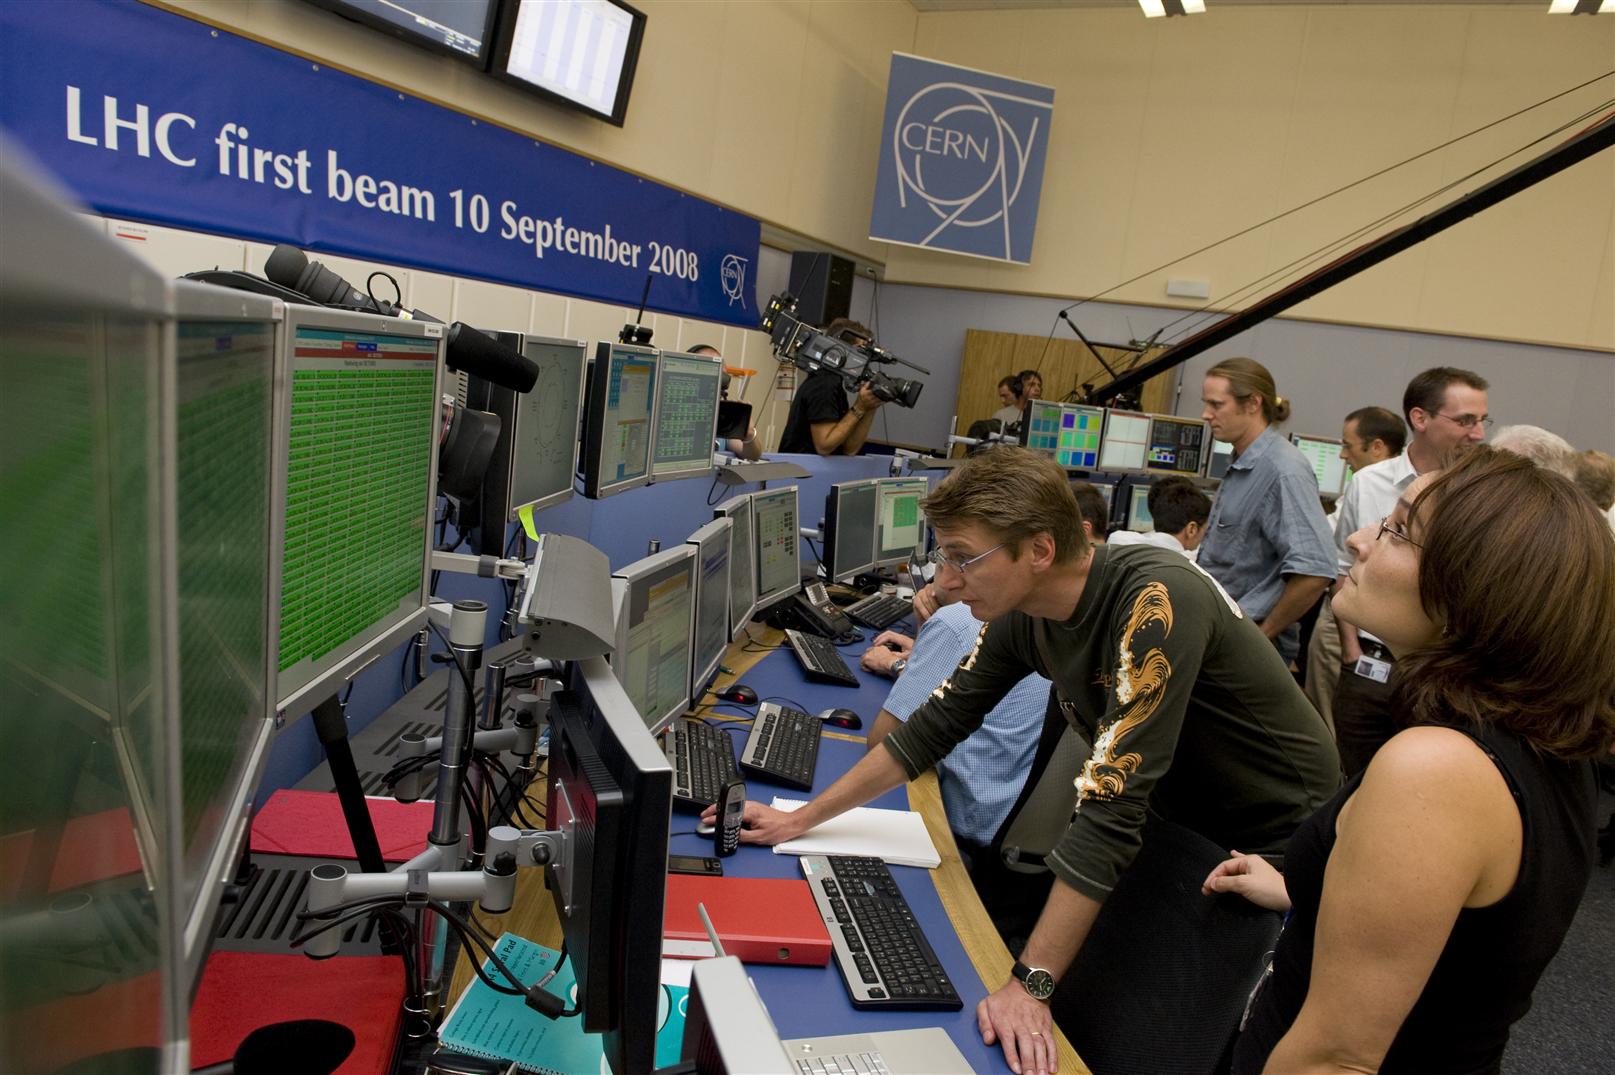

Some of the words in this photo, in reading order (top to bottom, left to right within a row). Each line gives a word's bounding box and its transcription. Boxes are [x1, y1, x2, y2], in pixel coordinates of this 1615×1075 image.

[902, 122, 989, 163] CERN
[66, 85, 197, 167] LHC
[214, 122, 313, 194] first
[327, 149, 435, 222] beam
[449, 189, 490, 233] 10
[500, 200, 641, 268] September
[648, 241, 699, 282] 2008
[503, 939, 517, 953] Pad
